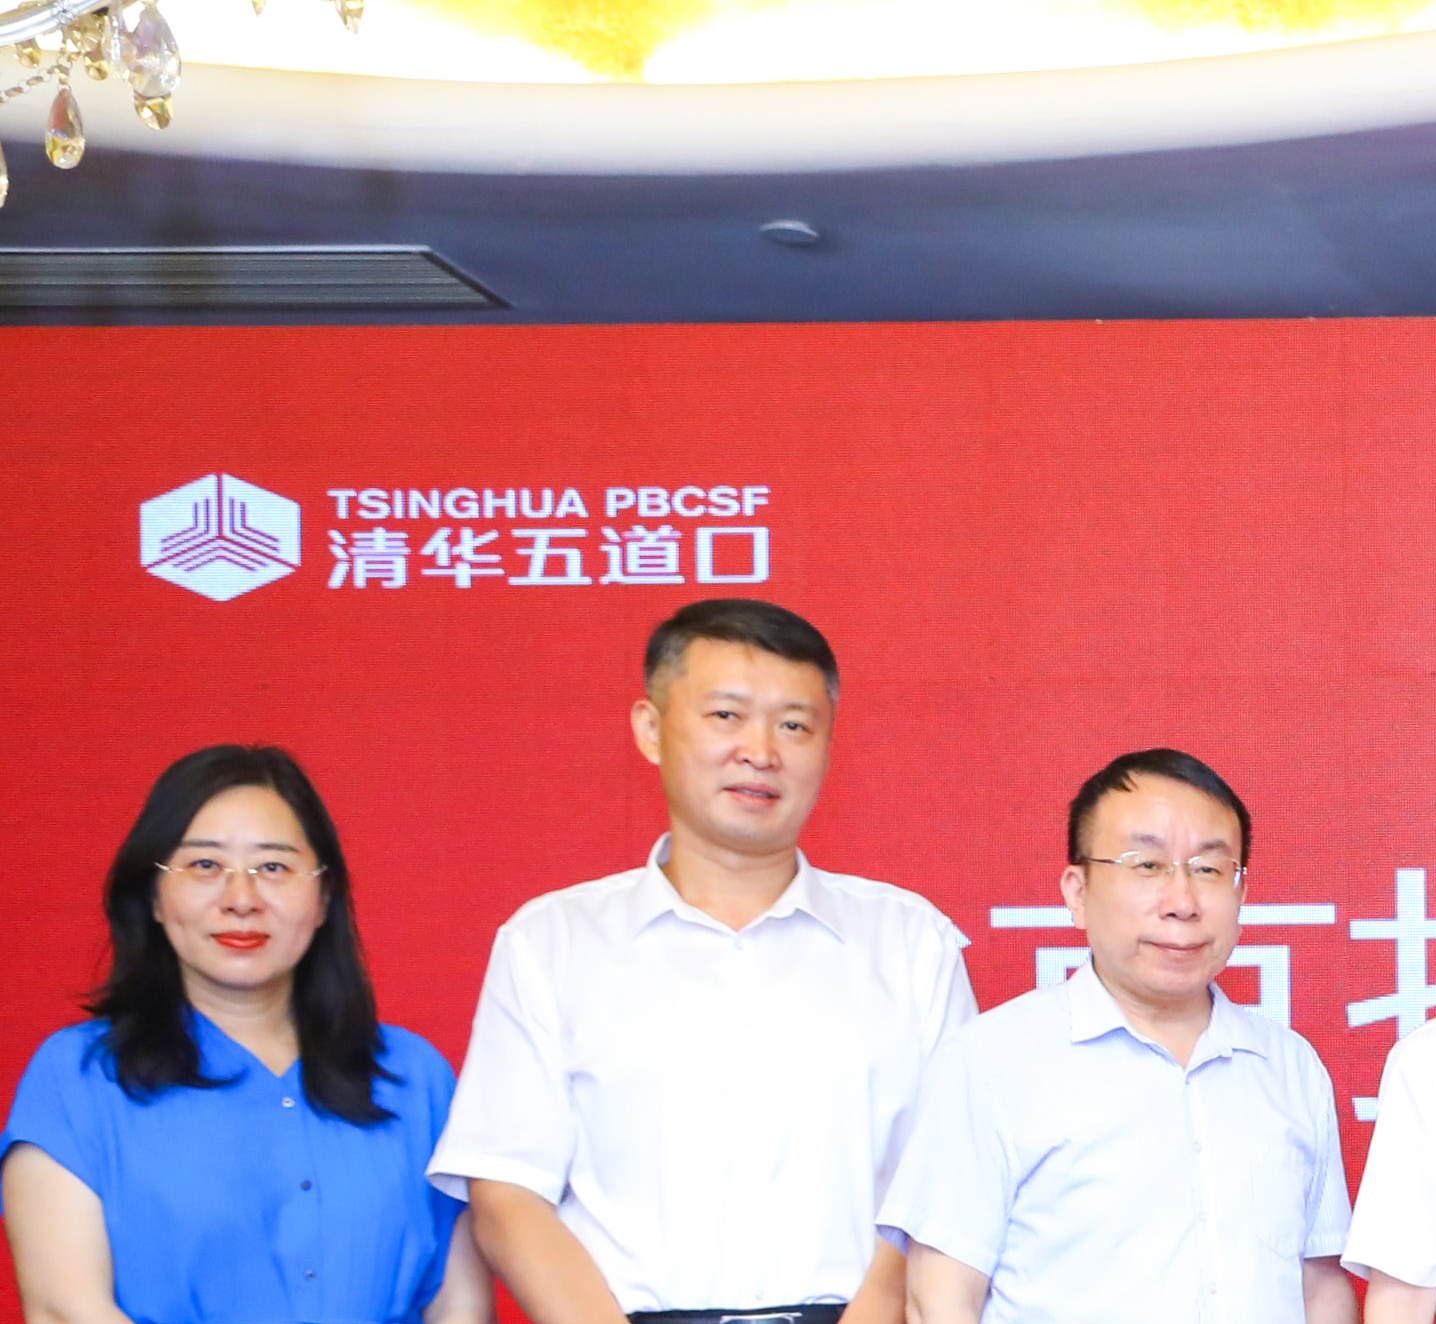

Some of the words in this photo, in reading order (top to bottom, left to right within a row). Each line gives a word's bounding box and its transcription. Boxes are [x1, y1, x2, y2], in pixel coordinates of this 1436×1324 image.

[327, 487, 589, 520] TSINGHUA
[605, 485, 772, 518] PBCSF
[327, 524, 771, 590] 清华五道口
